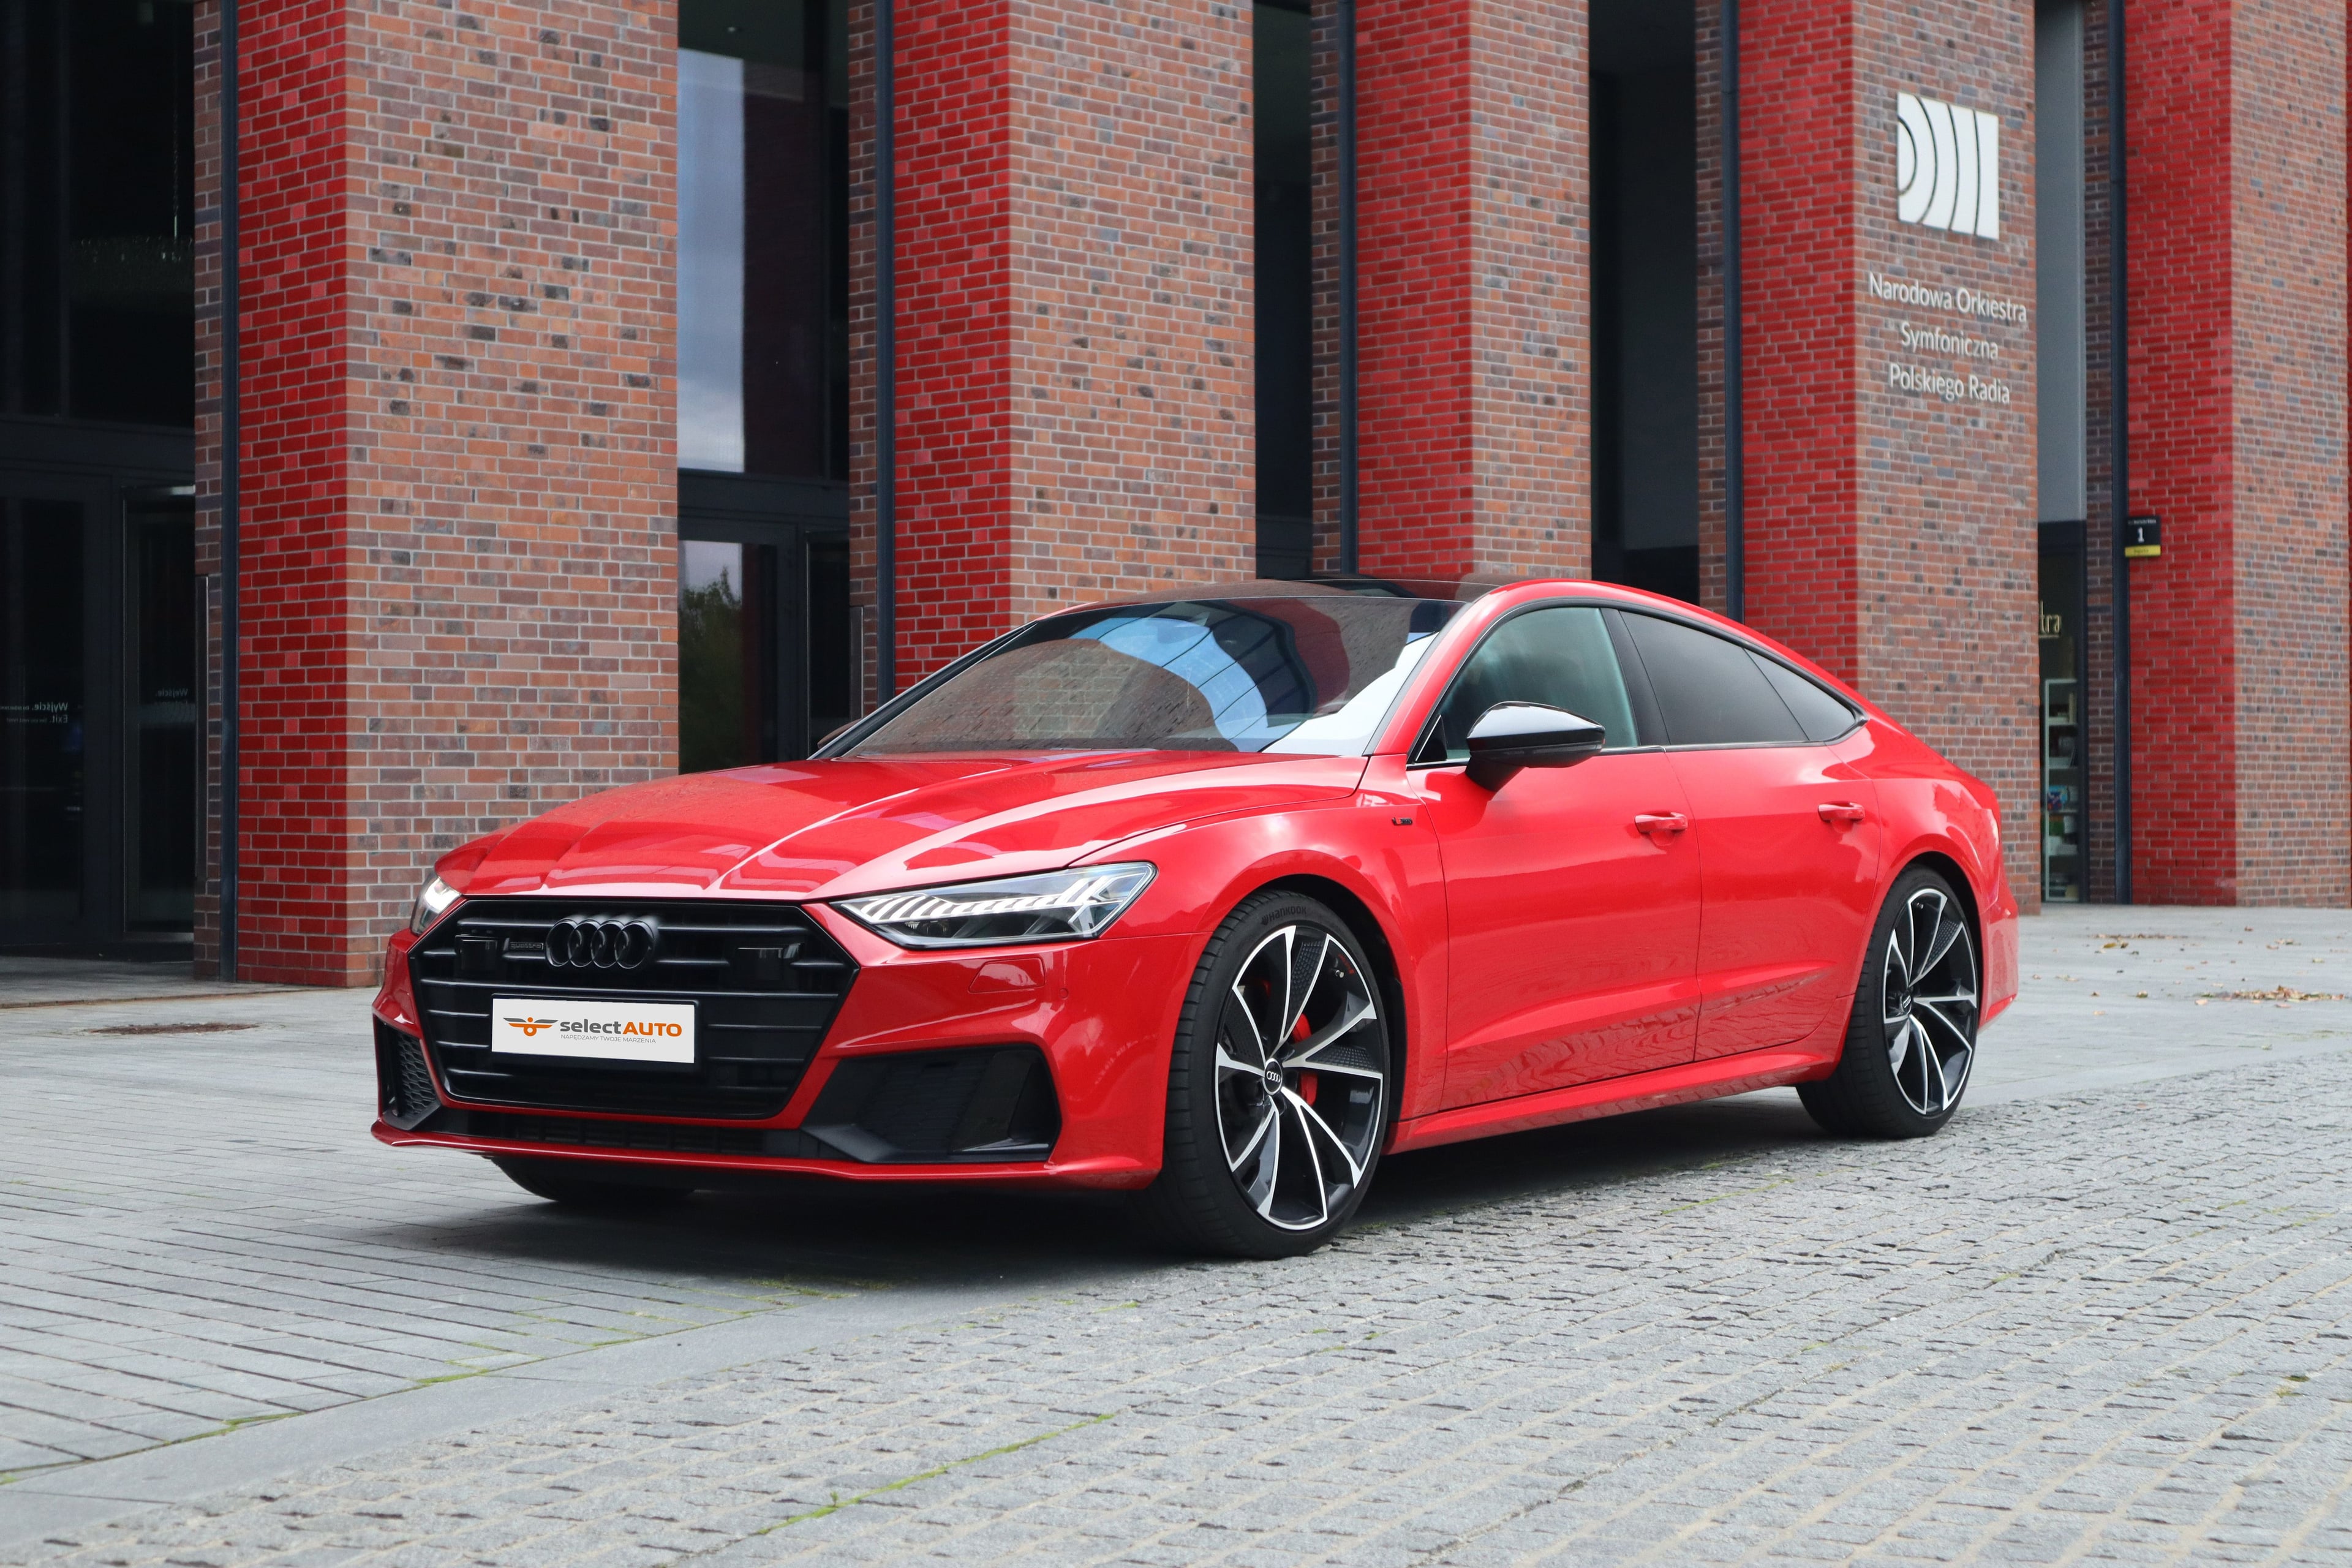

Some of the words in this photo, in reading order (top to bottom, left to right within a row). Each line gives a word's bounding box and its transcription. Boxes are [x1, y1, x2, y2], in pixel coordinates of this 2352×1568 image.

[1869, 272, 1952, 310] Narodowa
[1956, 287, 2027, 323] Orkiestra
[1901, 321, 1998, 360] Symfoniczna
[1890, 363, 1964, 401] Polskiego
[1968, 374, 2010, 404] Radia
[2138, 527, 2144, 543] 1
[560, 1019, 682, 1037] selectAUTO
